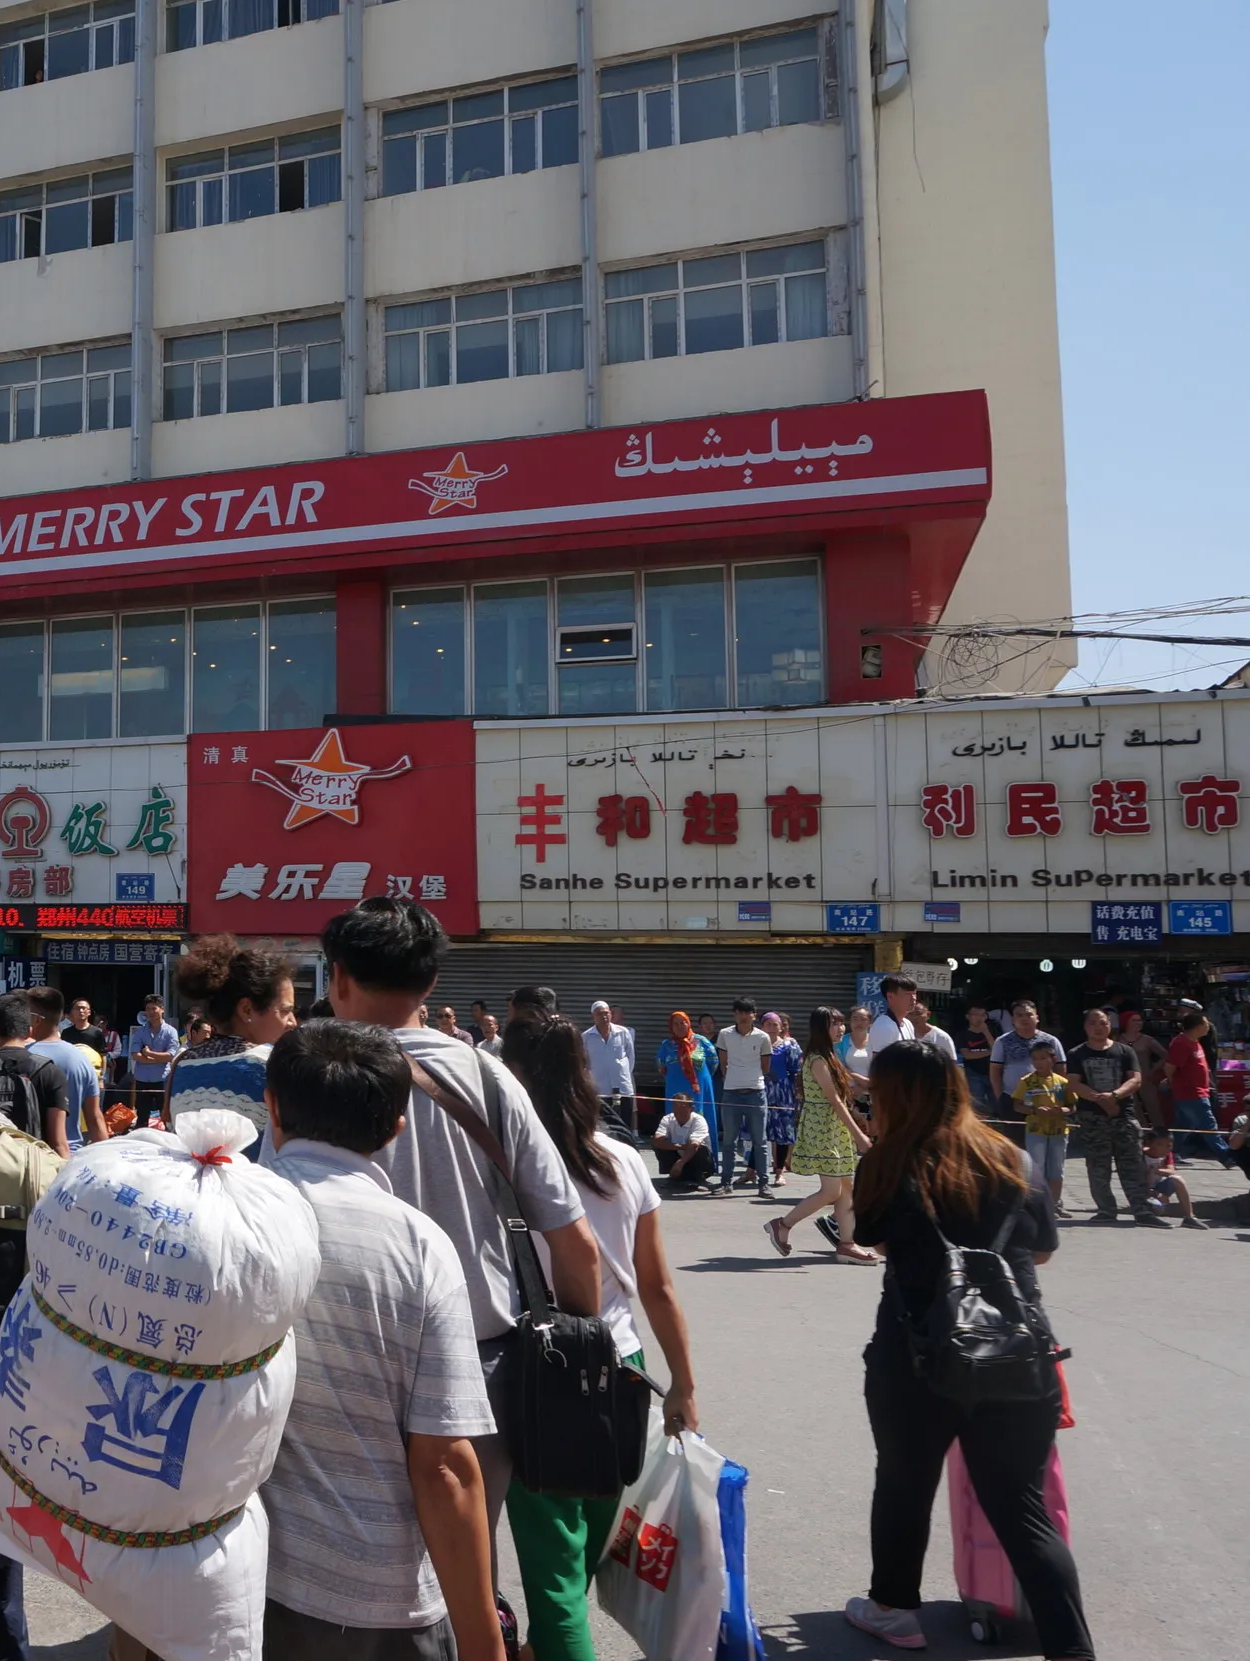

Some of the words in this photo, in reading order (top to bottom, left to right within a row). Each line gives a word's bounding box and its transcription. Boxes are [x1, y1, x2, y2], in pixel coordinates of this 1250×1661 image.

[434, 477, 477, 489] Merry
[439, 488, 476, 499] Star
[175, 480, 325, 537] STAR
[203, 745, 249, 763] 清真
[292, 767, 360, 791] Merry
[299, 787, 355, 806] Star
[920, 775, 1243, 839] 利民超市
[215, 861, 372, 901] 美乐星
[385, 874, 448, 901] 汉堡
[519, 873, 605, 890] Sanhe
[614, 872, 817, 894] Supermarket
[931, 867, 1018, 889] Limin
[125, 885, 146, 895] 149
[1095, 904, 1156, 920] 话费充值
[841, 916, 869, 927] 147
[1188, 916, 1213, 928] 145
[1096, 925, 1109, 941] 售
[1116, 925, 1159, 941] 充电宝
[7, 960, 48, 989] 机票
